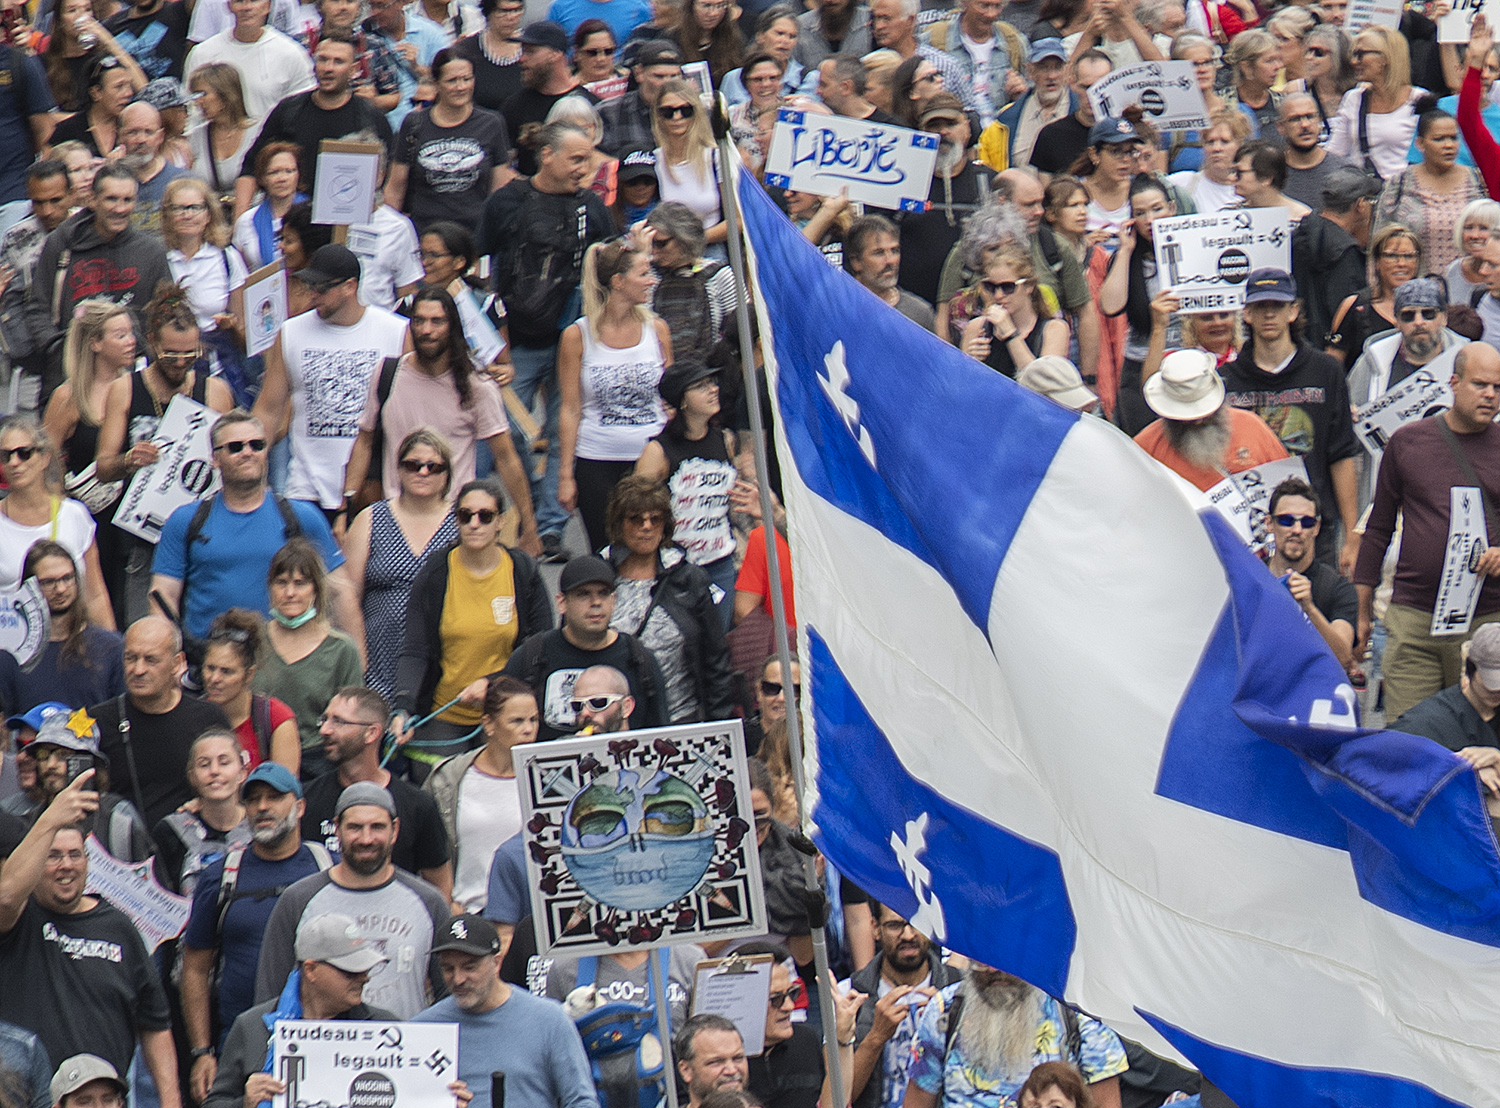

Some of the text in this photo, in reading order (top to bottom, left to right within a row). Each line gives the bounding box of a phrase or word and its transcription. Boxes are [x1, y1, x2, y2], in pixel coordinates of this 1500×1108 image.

[1158, 216, 1219, 233] trudeau
[1202, 233, 1256, 249] legault
[280, 1025, 358, 1042] trudeau
[333, 1052, 403, 1071] legault
[355, 1080, 391, 1092] VACCINE
[351, 1094, 395, 1107] PASSPORT
